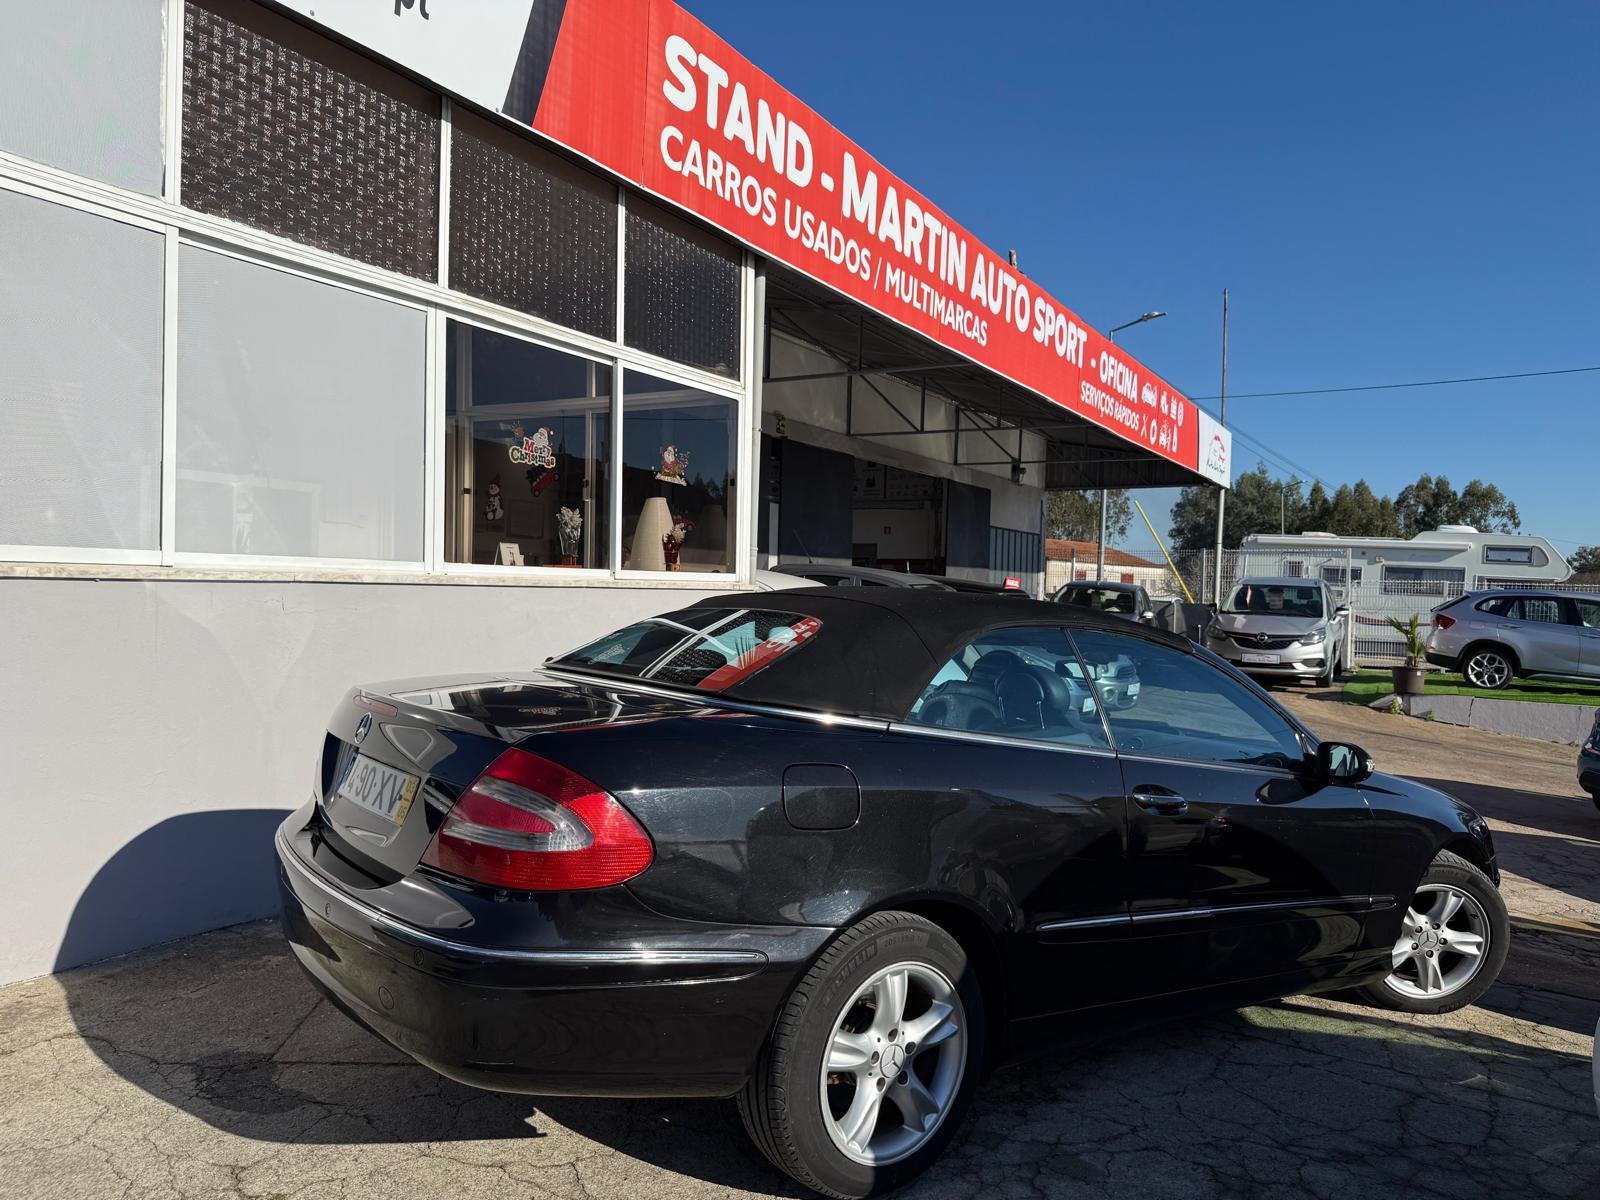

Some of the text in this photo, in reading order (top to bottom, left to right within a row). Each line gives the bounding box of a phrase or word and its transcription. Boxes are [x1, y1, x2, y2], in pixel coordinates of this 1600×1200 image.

[660, 125, 777, 228] CARROS
[784, 198, 871, 281] USADOS
[885, 262, 989, 348] MULTIMARCAS
[662, 34, 814, 188] STAND
[841, 151, 968, 294] MARTIN
[970, 253, 1031, 333] AUTO
[1032, 296, 1088, 369] SPORT
[1099, 350, 1138, 404] OFICINA
[1080, 380, 1140, 431] SERVIÇOS RÁPIDOS
[510, 446, 555, 467] Christmas
[524, 438, 552, 457] Merry
